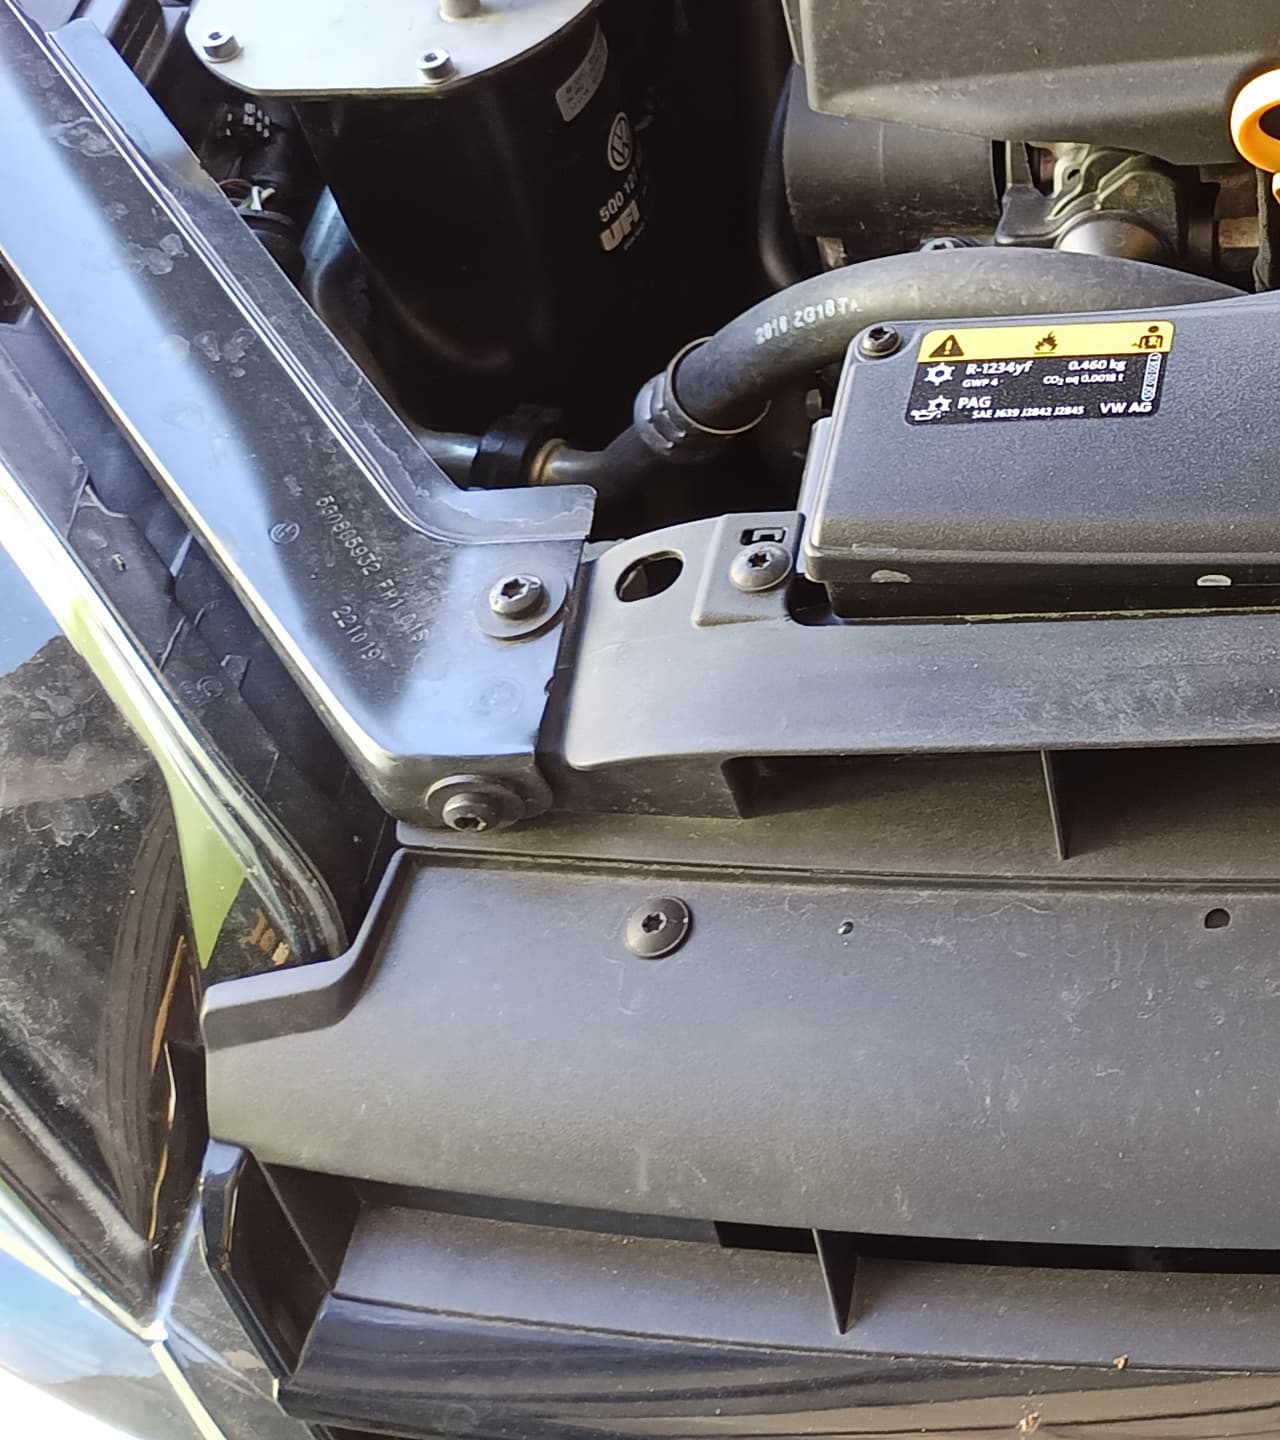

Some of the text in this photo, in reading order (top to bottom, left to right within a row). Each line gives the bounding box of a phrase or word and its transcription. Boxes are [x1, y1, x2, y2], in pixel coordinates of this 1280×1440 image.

[965, 359, 1126, 376] R-1234yf 0.460 kg
[962, 378, 989, 388] GWP
[991, 377, 999, 386] 4
[1065, 376, 1080, 387] eq
[1081, 374, 1116, 384] 0.0018
[957, 396, 1152, 414] PAG VW AG
[971, 405, 1085, 420] SAE J639 J2842 J2845
[331, 604, 385, 661] 221019
